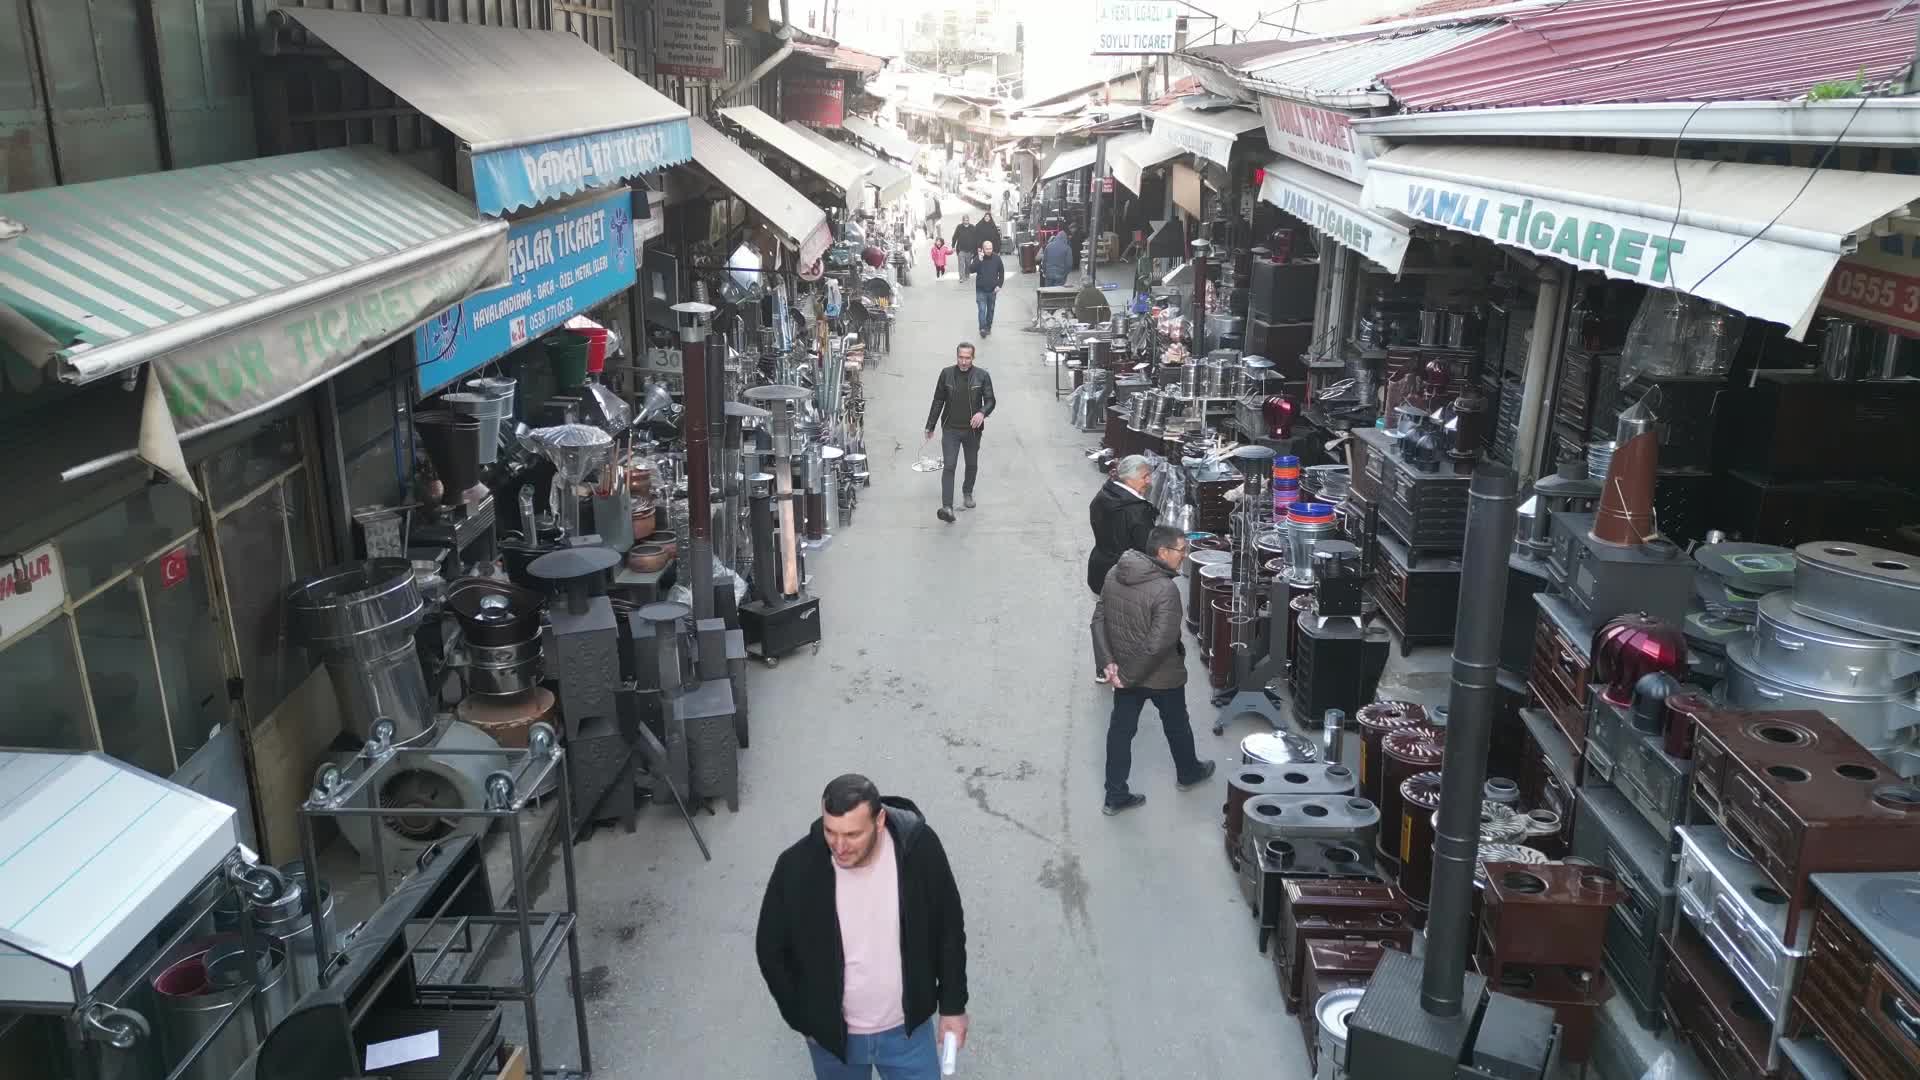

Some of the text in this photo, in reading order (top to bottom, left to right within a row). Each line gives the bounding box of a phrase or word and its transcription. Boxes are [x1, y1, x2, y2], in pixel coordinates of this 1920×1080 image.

[1100, 34, 1130, 49] SOYLU
[1282, 188, 1374, 253] VANLI TİCARET
[1408, 183, 1687, 284] VANLI TİCARET
[508, 231, 554, 283] AŞLAR
[555, 209, 605, 257] TİCARET
[1838, 270, 1896, 307] 0555
[472, 289, 532, 331] HAVALANDIRMA
[656, 351, 679, 367] 30
